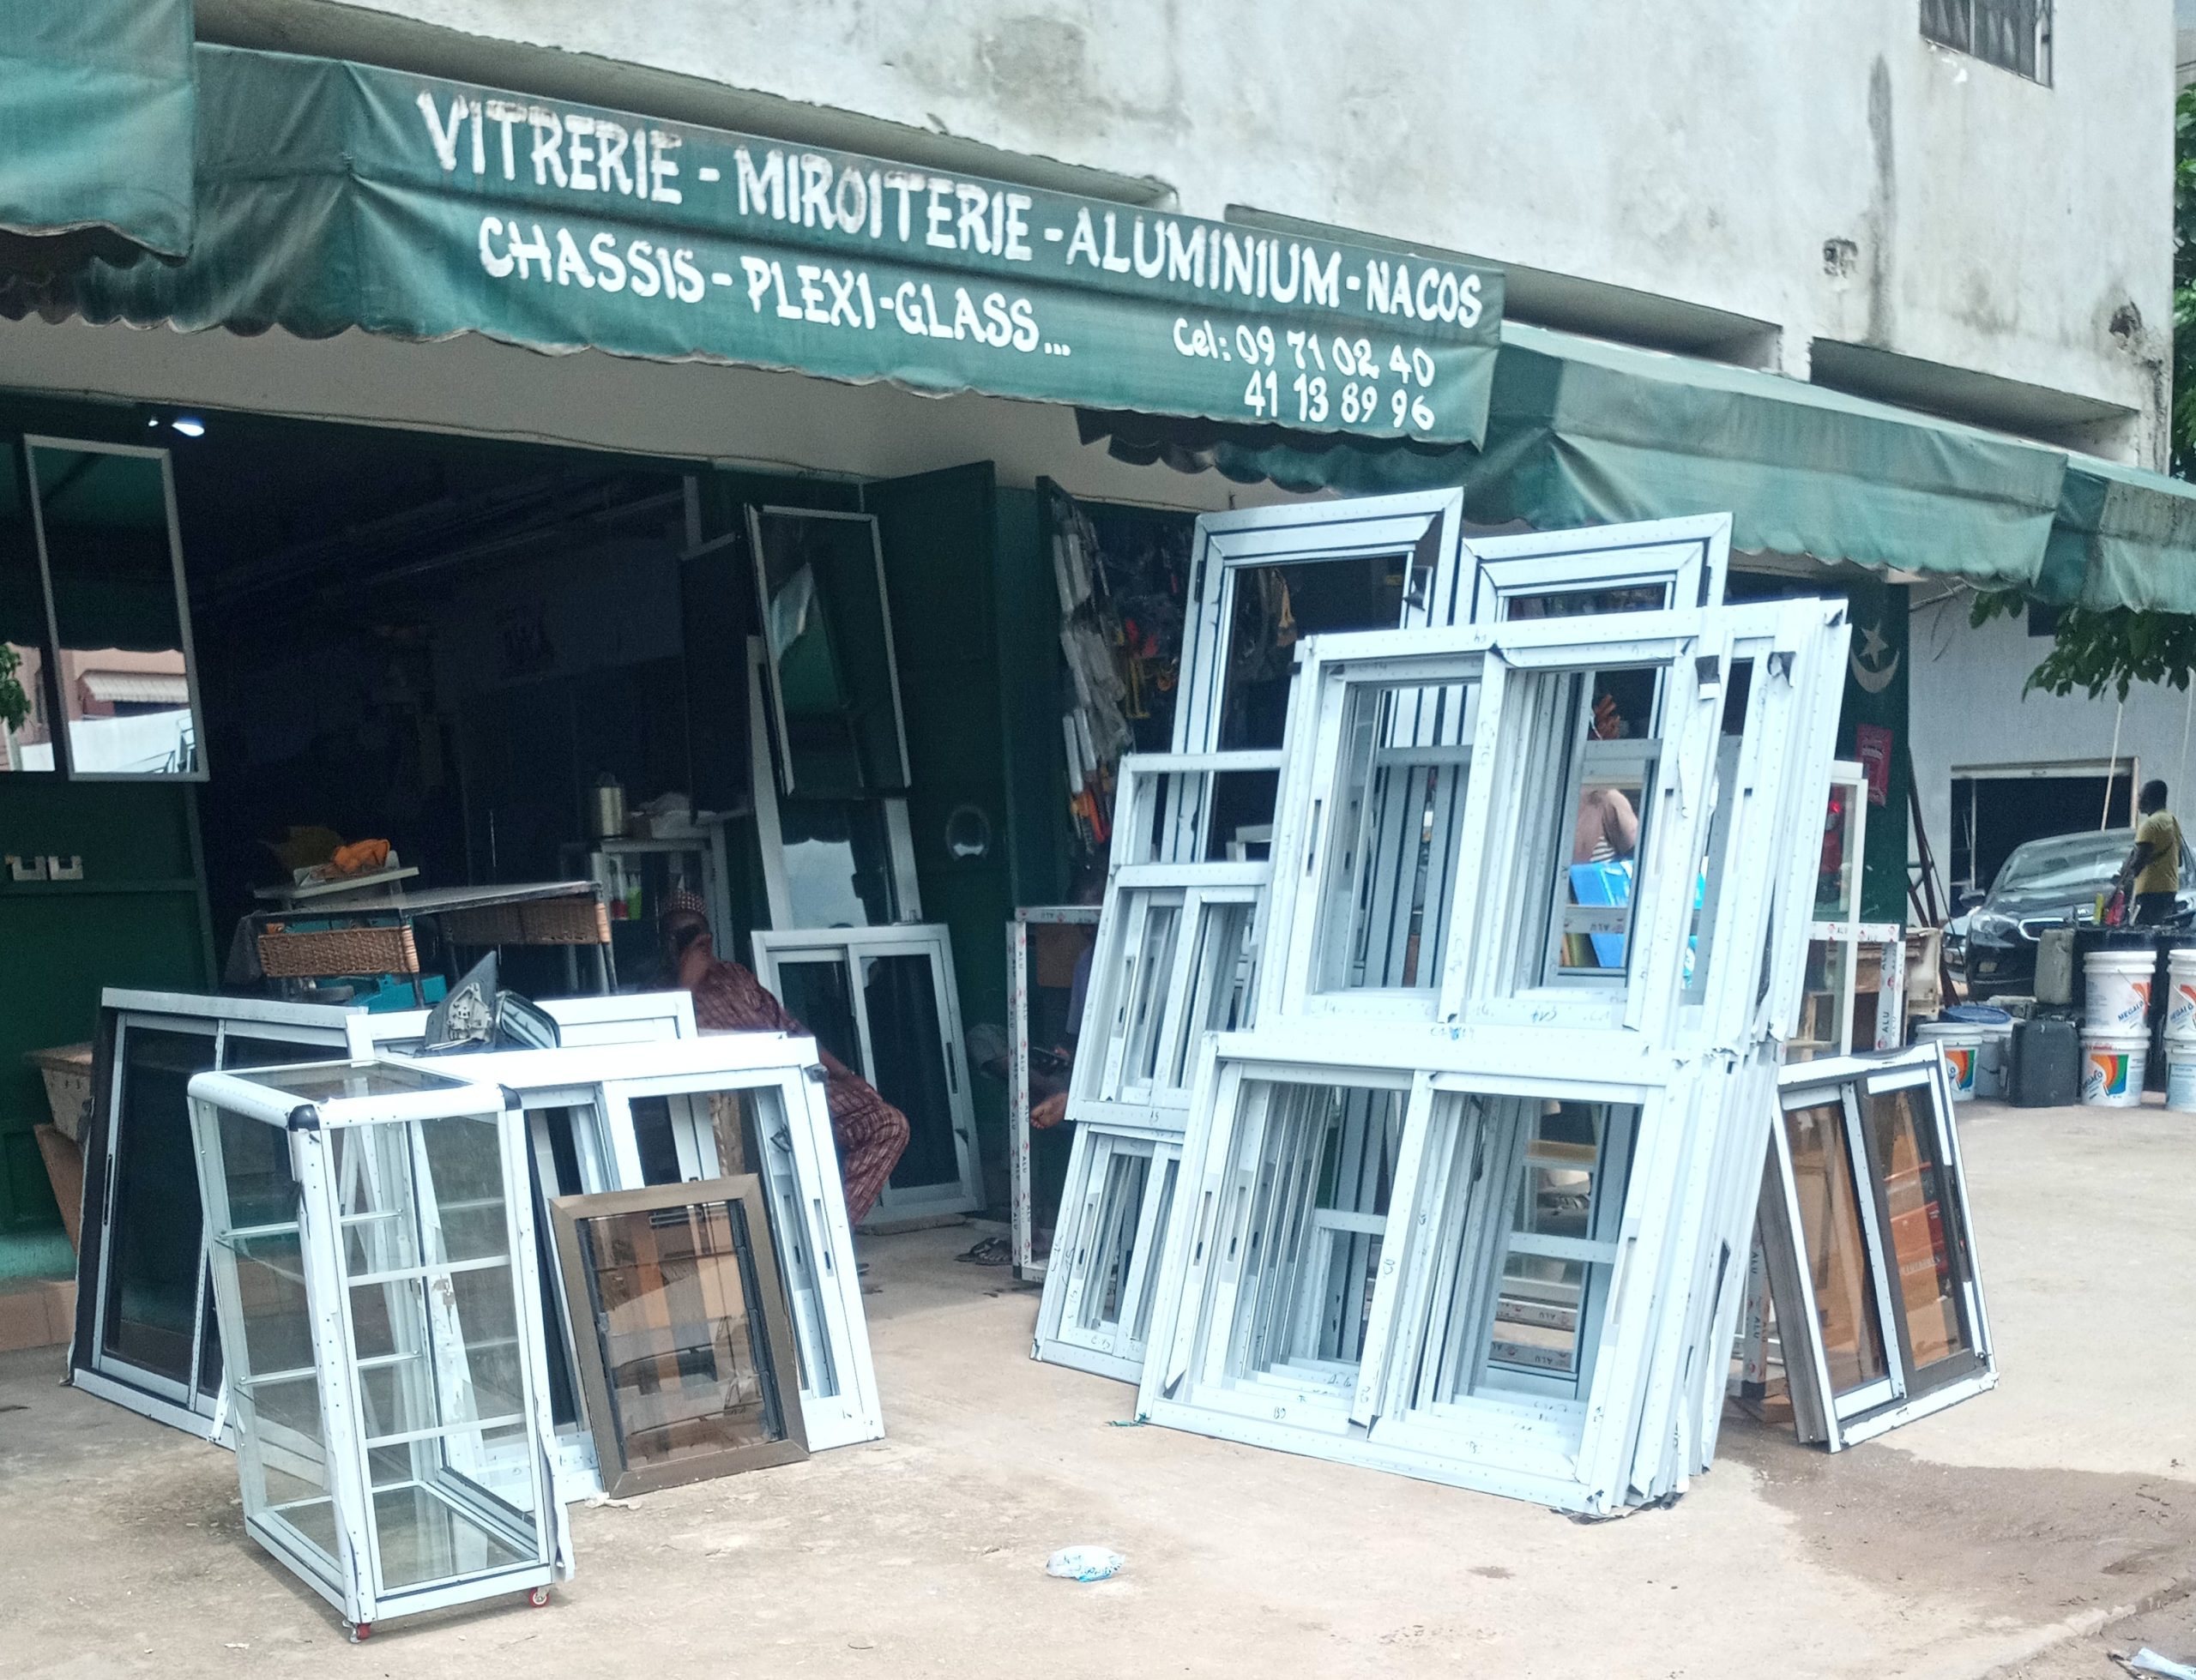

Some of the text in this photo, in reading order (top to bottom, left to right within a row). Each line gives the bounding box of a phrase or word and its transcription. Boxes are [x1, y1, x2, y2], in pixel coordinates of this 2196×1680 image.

[417, 90, 682, 204] VITRERIE
[734, 145, 1033, 261] MIROITERIE
[1172, 317, 1435, 388] Cel: 09 71 02 40
[1244, 370, 1436, 431] 41 13 89 96
[1881, 1011, 1891, 1033] ALU
[1751, 1251, 1759, 1274] ALU
[1535, 1355, 1553, 1365] ALU
